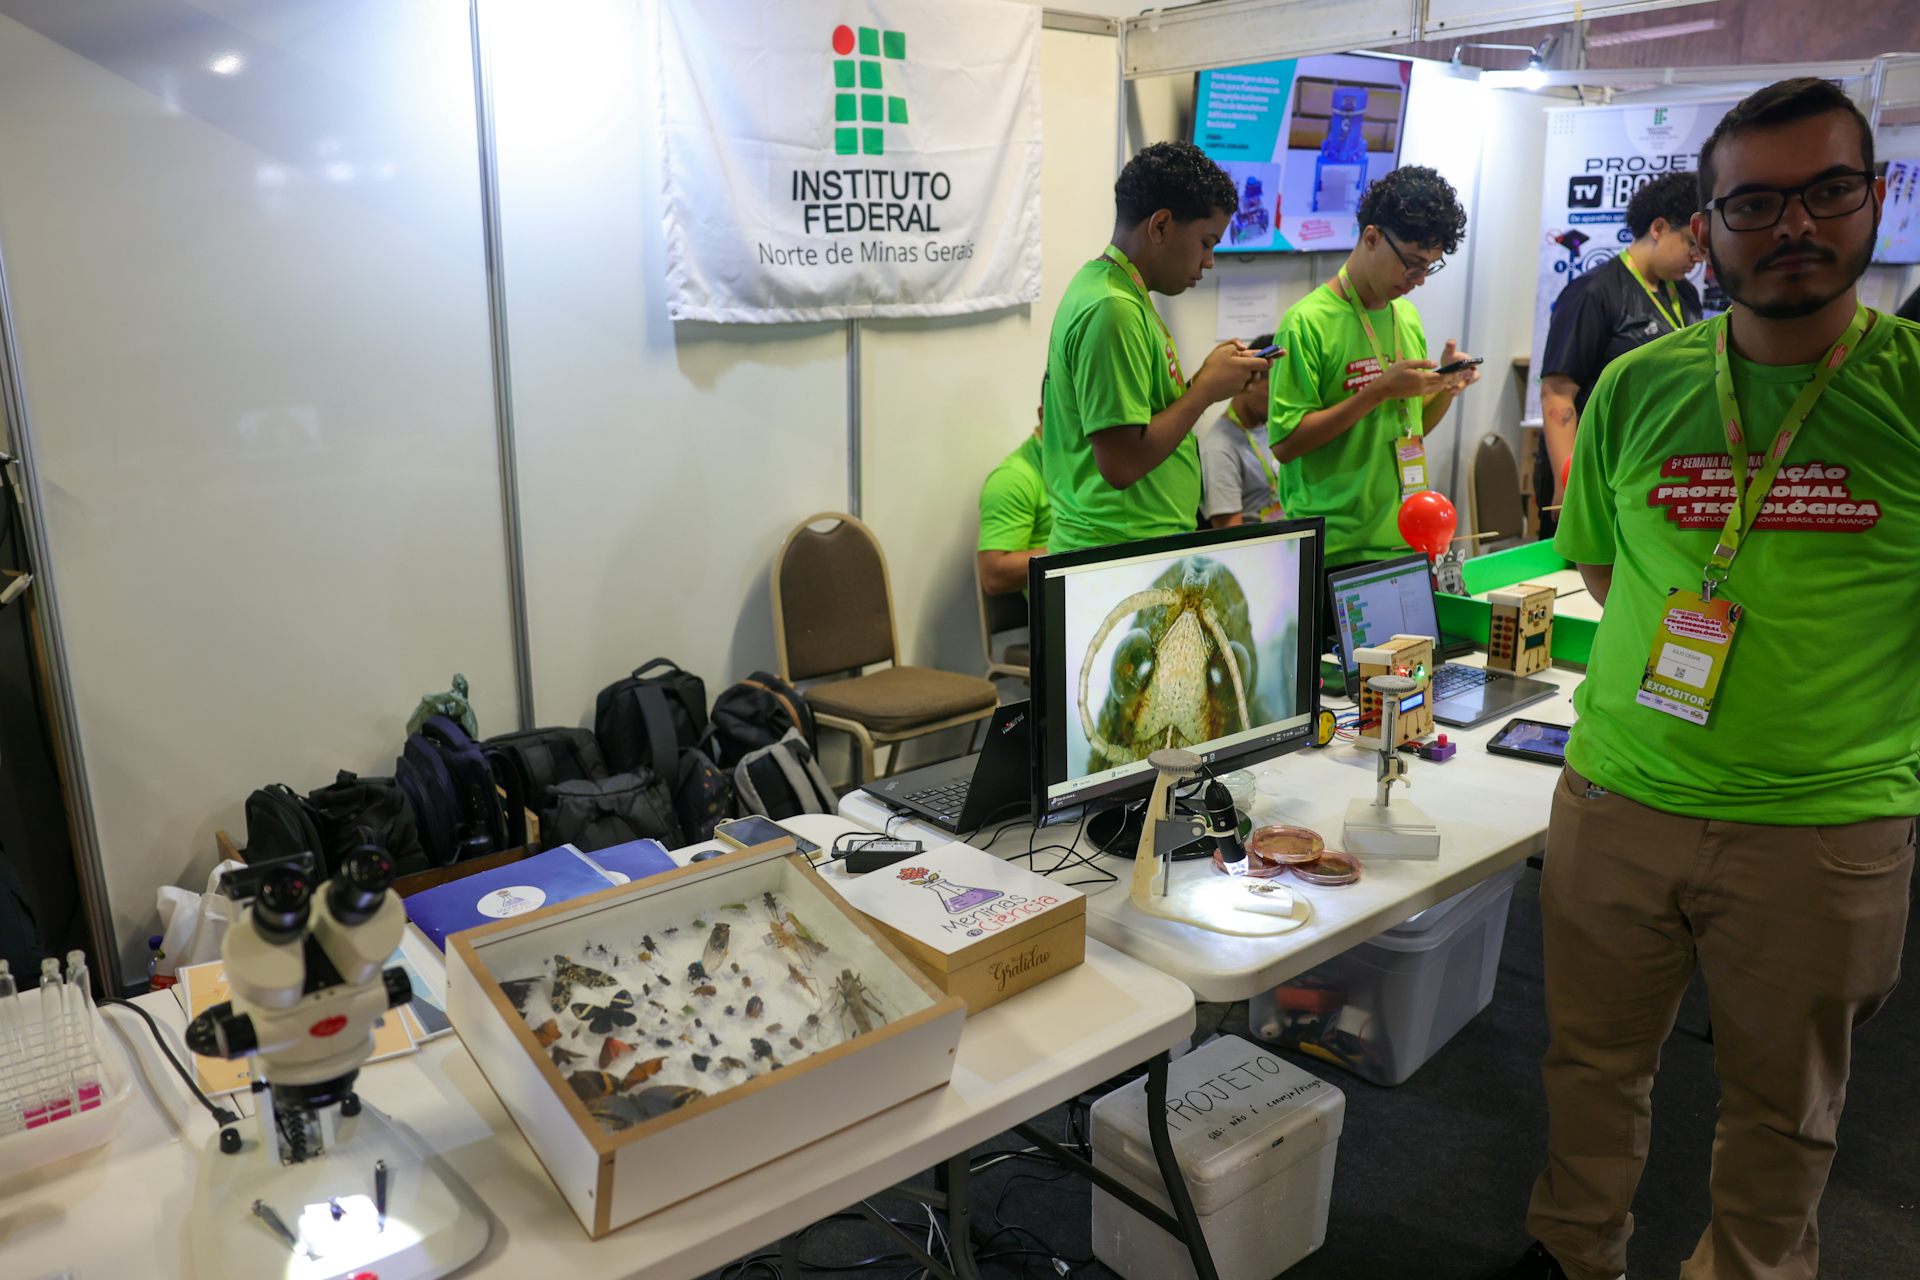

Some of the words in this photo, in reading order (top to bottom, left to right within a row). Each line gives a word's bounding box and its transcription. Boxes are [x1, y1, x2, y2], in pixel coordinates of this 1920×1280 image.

[1585, 154, 1699, 173] PROJET
[792, 169, 951, 201] INSTITUTO
[1573, 184, 1598, 200] TV
[1615, 174, 1659, 207] BO
[804, 203, 940, 234] FEDERAL
[758, 242, 818, 266] Norte
[826, 242, 853, 265] de
[860, 241, 918, 264] Minas
[924, 239, 974, 262] Gerais
[1682, 456, 1719, 469] SEMANA
[1701, 464, 1846, 483] EDAÇÃO
[1657, 485, 1847, 499] PROFISONAL
[1691, 499, 1878, 517] TECOLÓGICA
[1786, 516, 1814, 524] BRASIL
[1838, 518, 1874, 526] AVANÇA
[1645, 680, 1706, 706] EXPOSITOR
[941, 894, 1028, 933] Meninas
[979, 896, 1058, 931] Ciência
